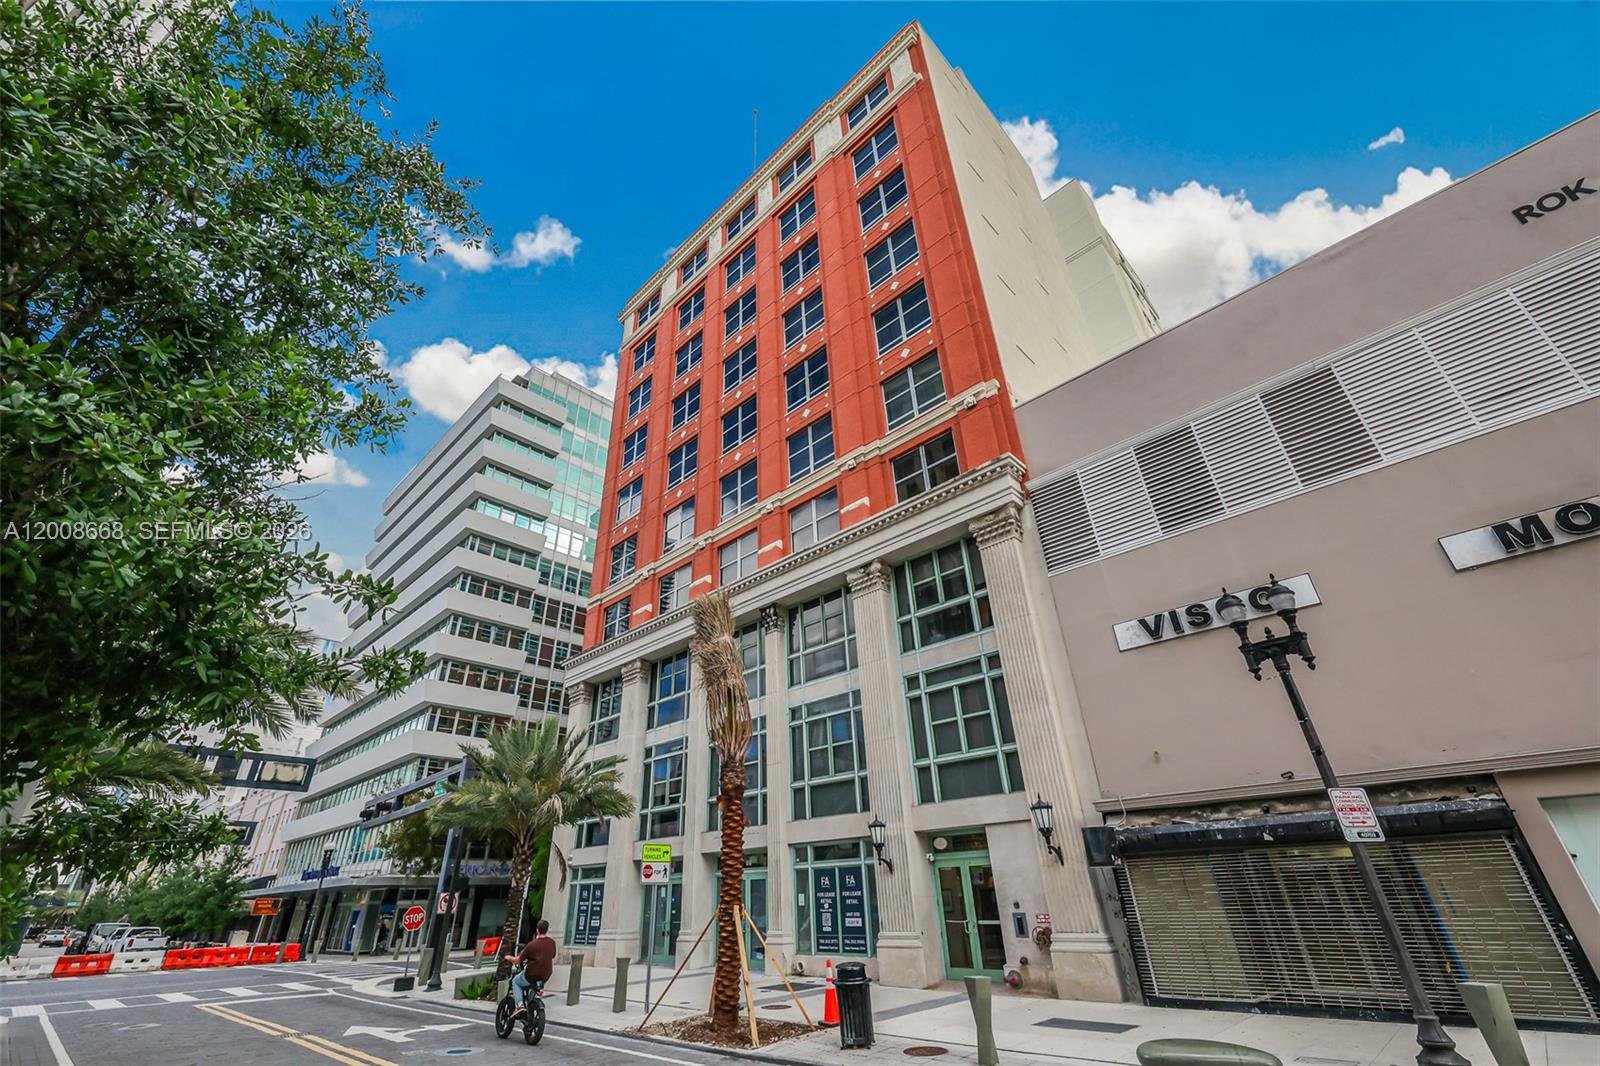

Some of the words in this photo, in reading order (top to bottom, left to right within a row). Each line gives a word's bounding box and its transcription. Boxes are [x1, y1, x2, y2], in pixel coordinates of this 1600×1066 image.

[1511, 177, 1598, 225] ROK
[1491, 502, 1600, 554] MO
[404, 912, 424, 925] STOP
